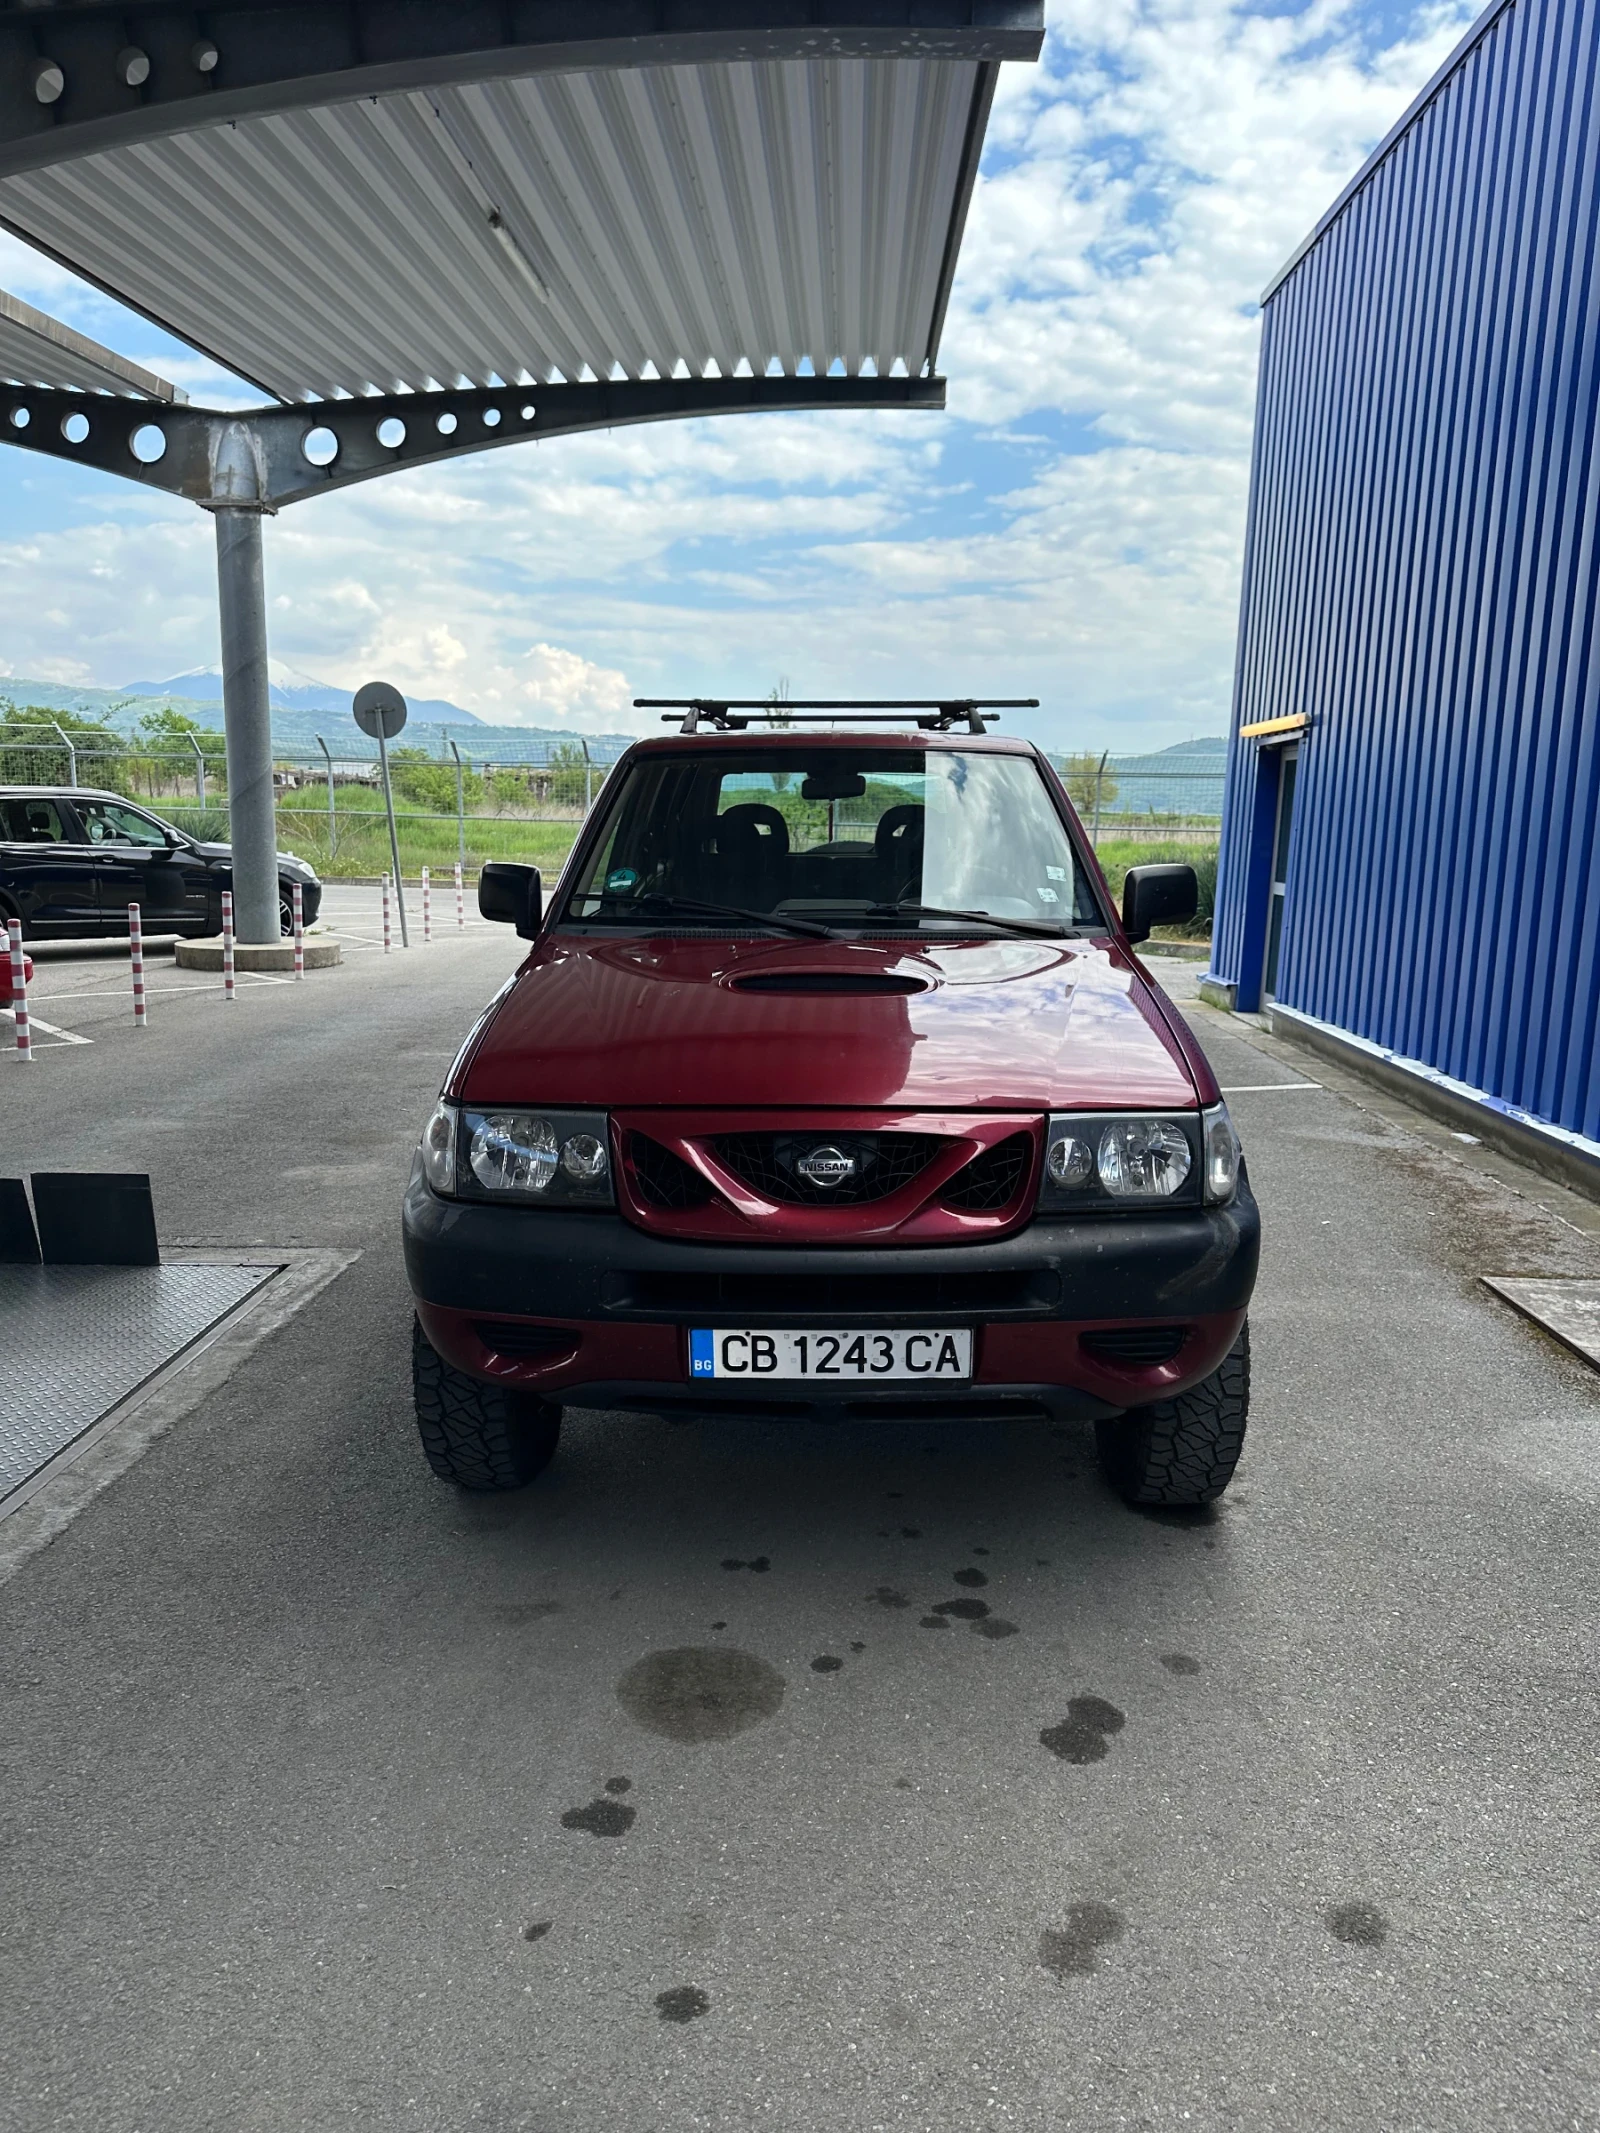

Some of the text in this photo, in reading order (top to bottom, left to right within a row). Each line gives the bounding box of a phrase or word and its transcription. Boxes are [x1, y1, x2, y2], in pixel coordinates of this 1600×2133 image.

[804, 1162, 848, 1172] NISSAN
[721, 1334, 961, 1374] CB 1243 CA
[694, 1359, 712, 1371] BG
